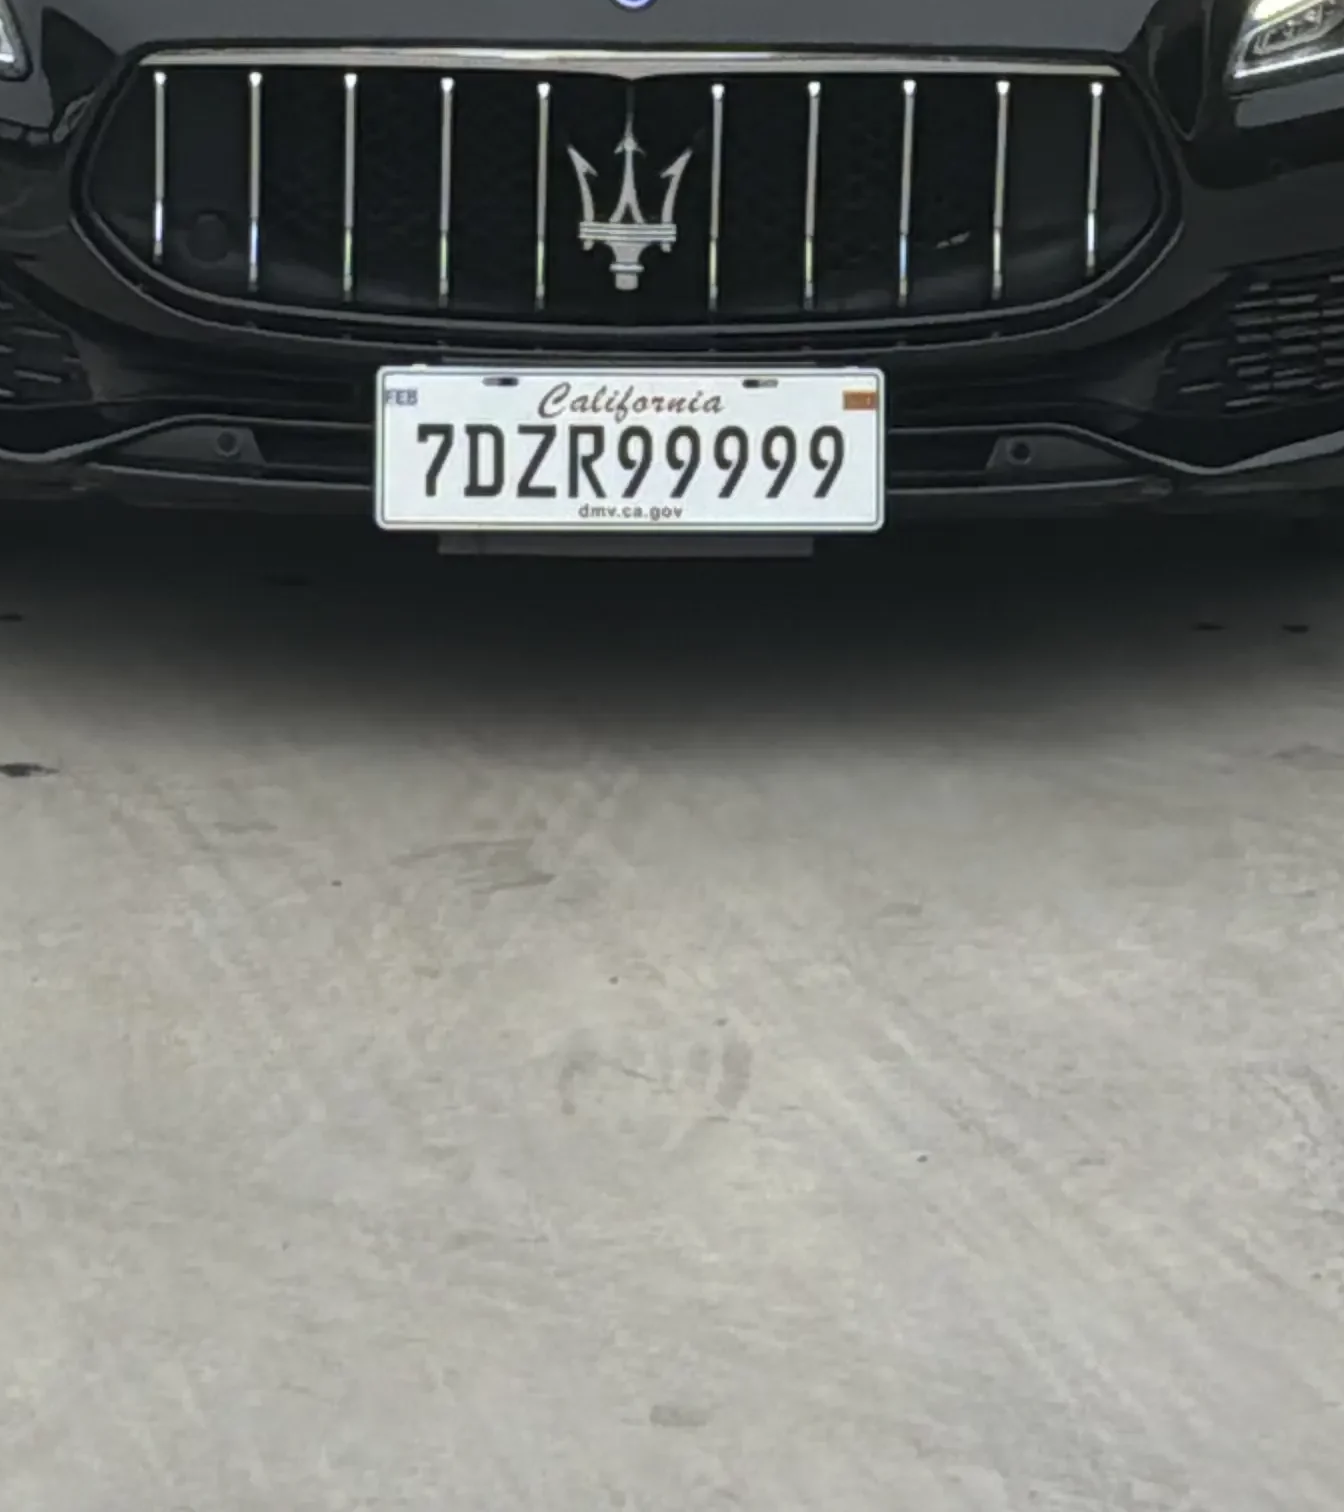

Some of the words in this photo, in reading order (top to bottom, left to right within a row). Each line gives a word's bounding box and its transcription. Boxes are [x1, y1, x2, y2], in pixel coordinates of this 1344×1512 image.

[537, 381, 727, 423] California
[416, 423, 845, 499] 7DZR99999
[578, 503, 684, 521] dmv.ca.gov
